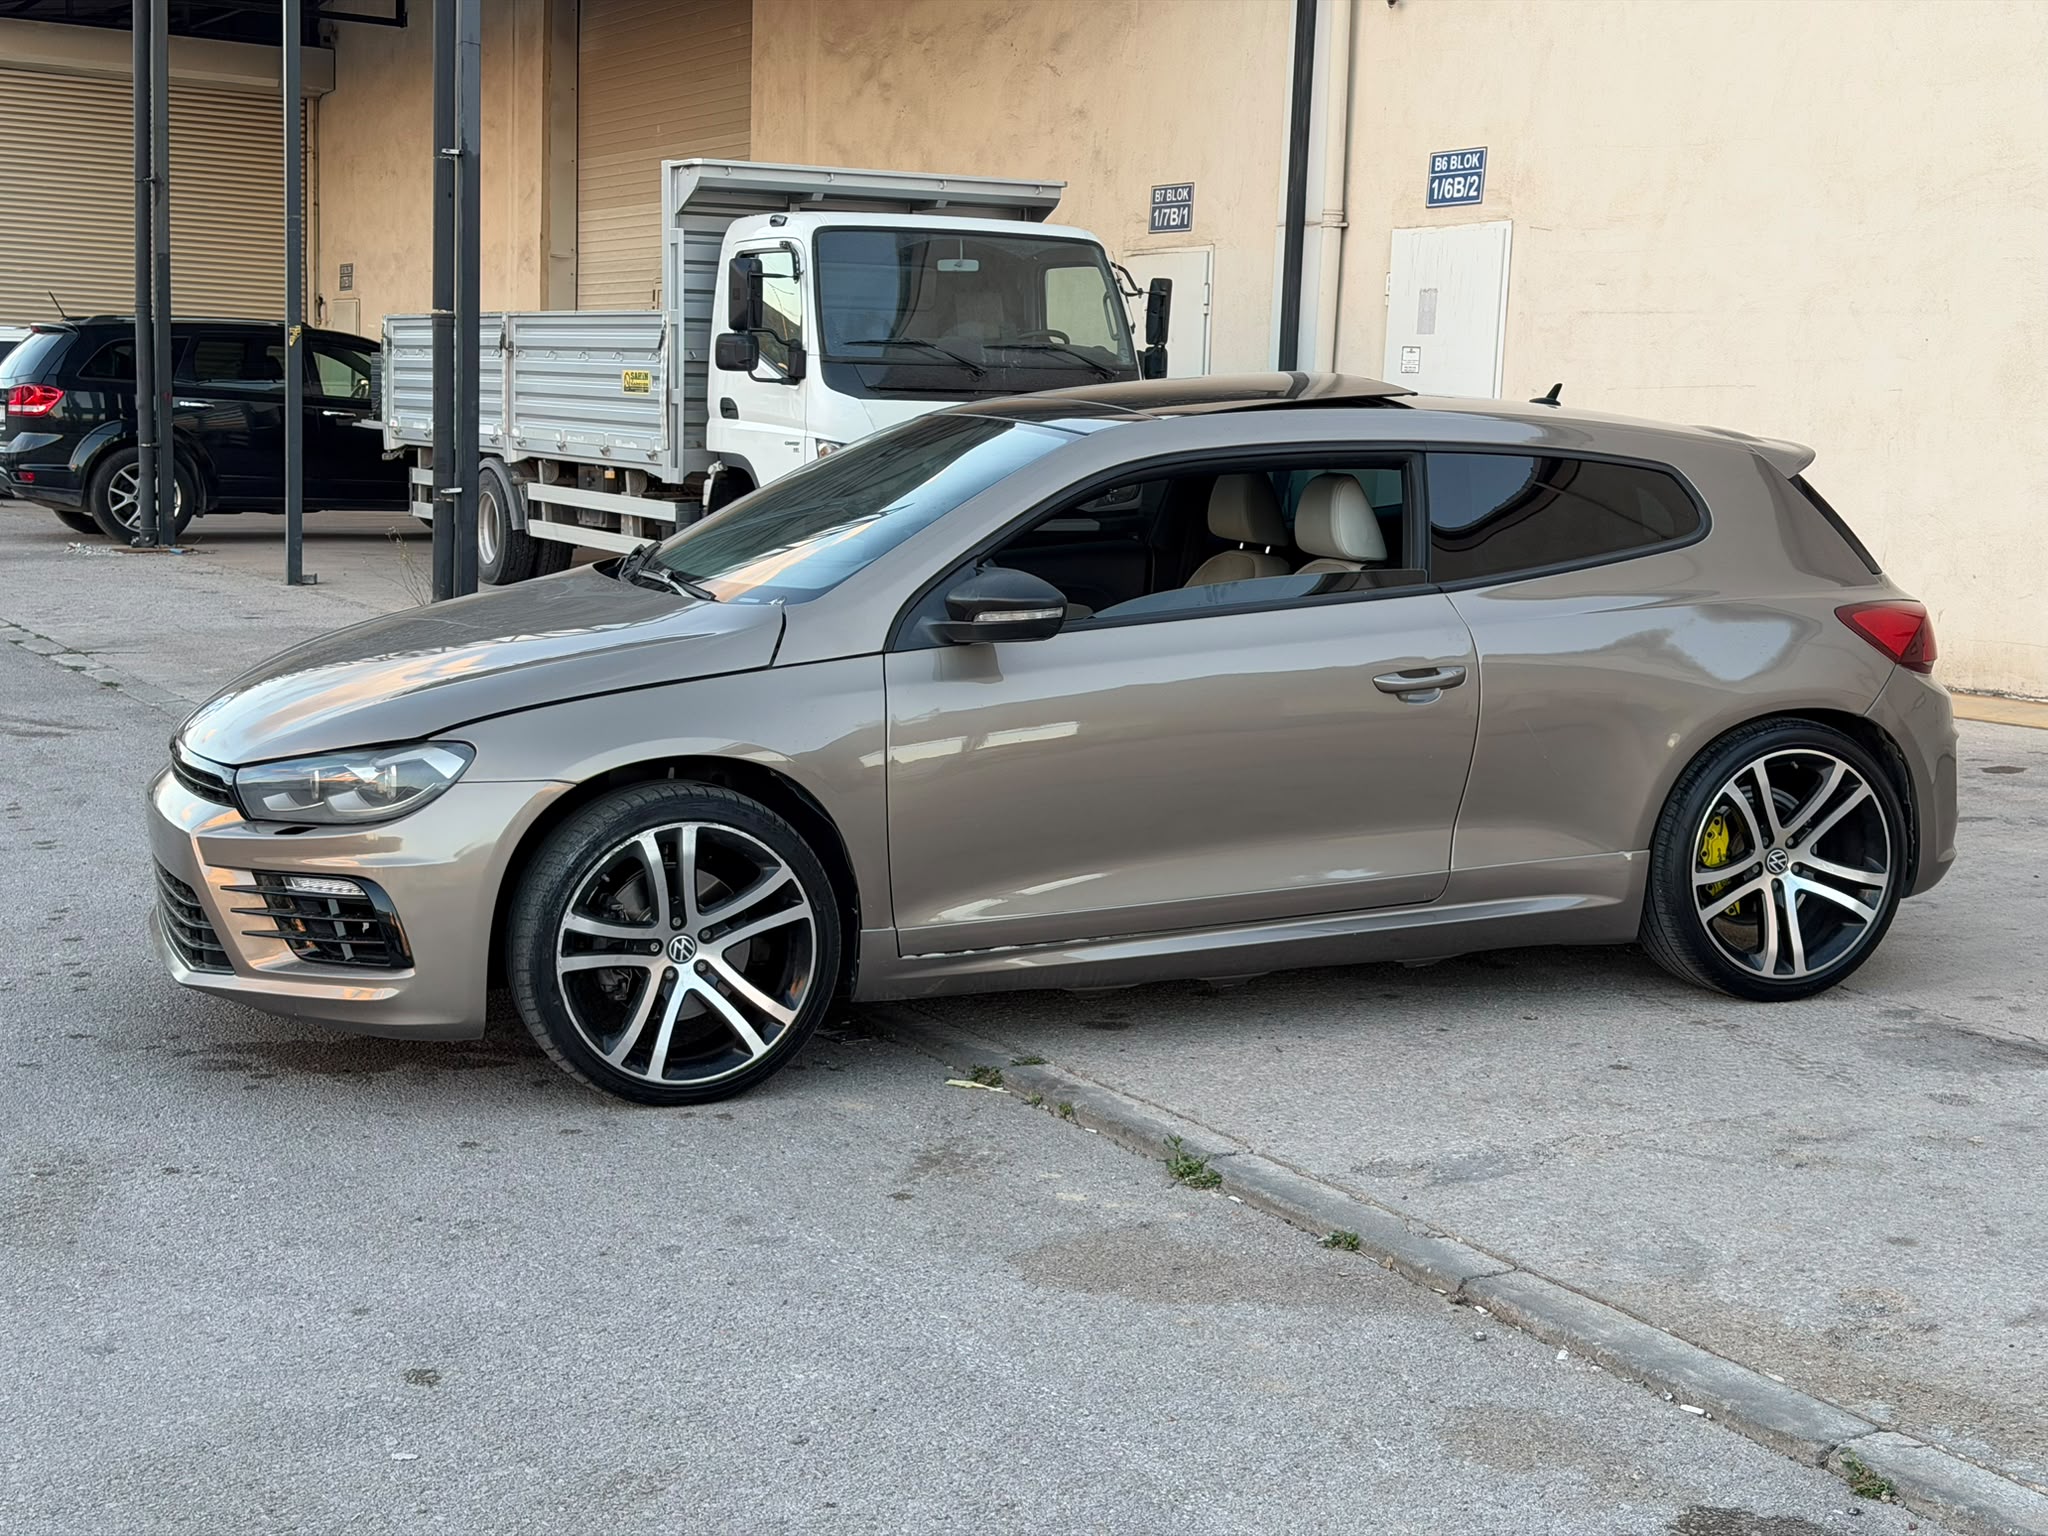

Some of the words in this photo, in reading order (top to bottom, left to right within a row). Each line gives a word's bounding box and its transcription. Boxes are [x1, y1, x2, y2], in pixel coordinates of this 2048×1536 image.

[1435, 157, 1448, 171] B6
[1450, 153, 1480, 170] BLOK
[1155, 190, 1165, 202] B7
[1166, 187, 1189, 201] BLOK
[1432, 176, 1479, 199] 1/6B/2
[1153, 207, 1188, 226] 1/7B/1
